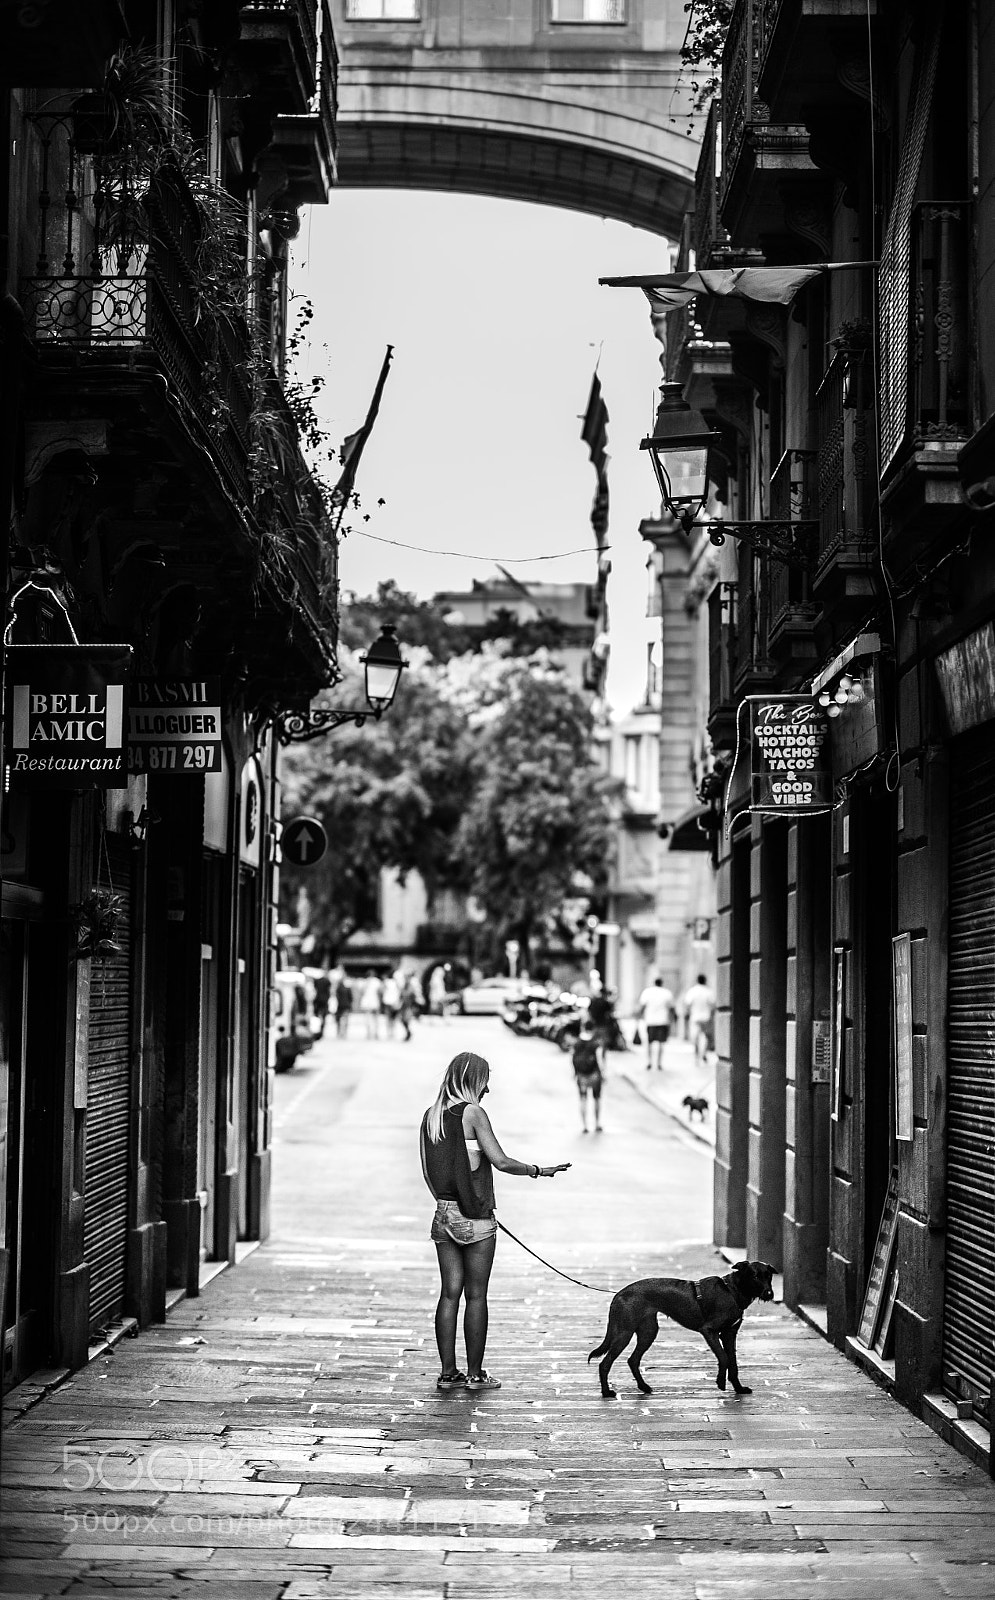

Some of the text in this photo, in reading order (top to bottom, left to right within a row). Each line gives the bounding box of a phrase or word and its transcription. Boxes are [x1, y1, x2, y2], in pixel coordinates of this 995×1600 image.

[31, 694, 106, 714] BELL
[757, 704, 787, 724] The
[30, 720, 105, 741] AMIC
[135, 715, 216, 734] LLOGUER
[754, 724, 828, 736] COCKTAILS
[758, 736, 824, 747] HOTDOGS
[149, 746, 177, 769] 877
[183, 745, 215, 768] 297
[763, 747, 820, 759] NACHOS
[13, 753, 122, 771] Restaurant
[768, 759, 815, 770] TACOS
[786, 771, 797, 781] &
[771, 782, 813, 793] GOOD
[772, 793, 812, 804] VIBES
